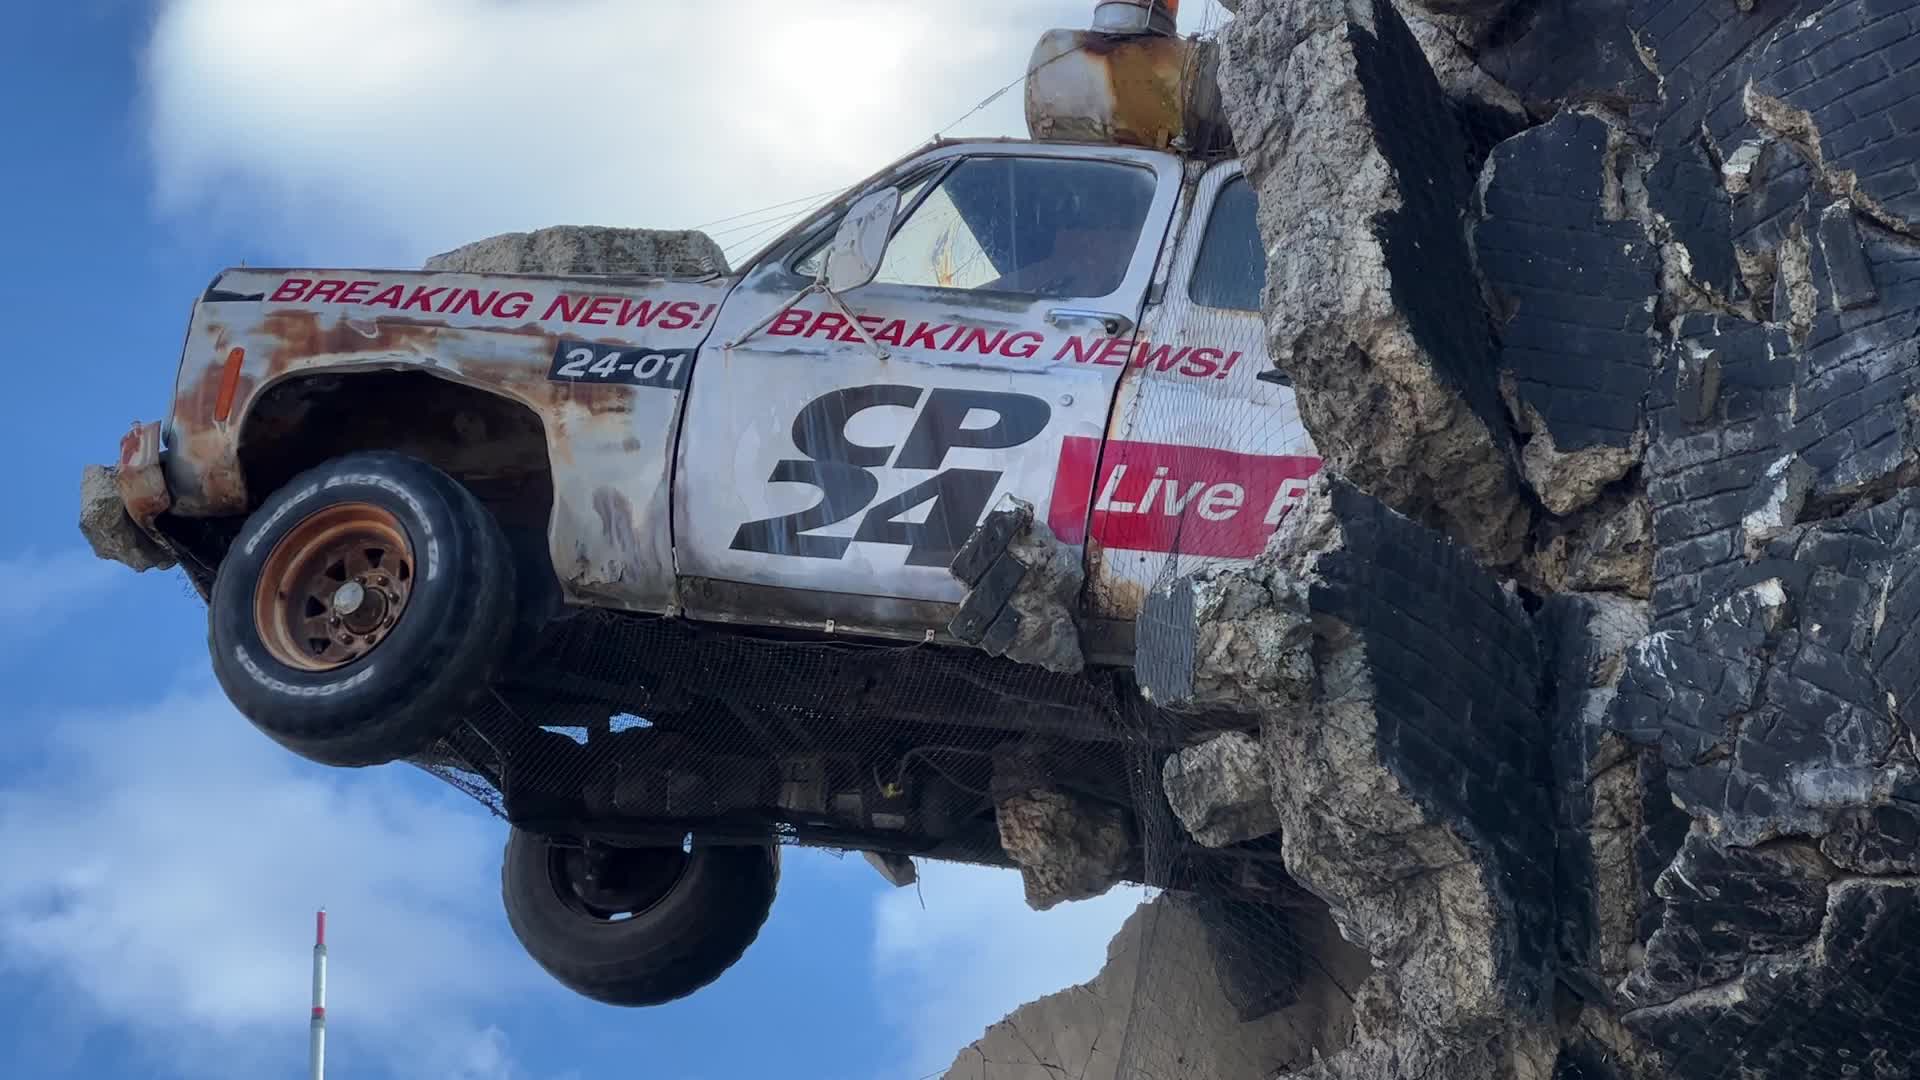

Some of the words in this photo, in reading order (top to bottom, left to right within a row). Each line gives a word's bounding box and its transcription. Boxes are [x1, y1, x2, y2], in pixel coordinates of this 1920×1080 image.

[269, 278, 534, 319] BREAKING
[540, 293, 718, 330] NEWS!
[556, 347, 687, 382] 24-01
[765, 308, 1045, 359] BREAKING
[1051, 335, 1242, 380] NEWS!
[791, 384, 1052, 470] CP
[728, 459, 1004, 567] 24
[1094, 463, 1245, 522] Live
